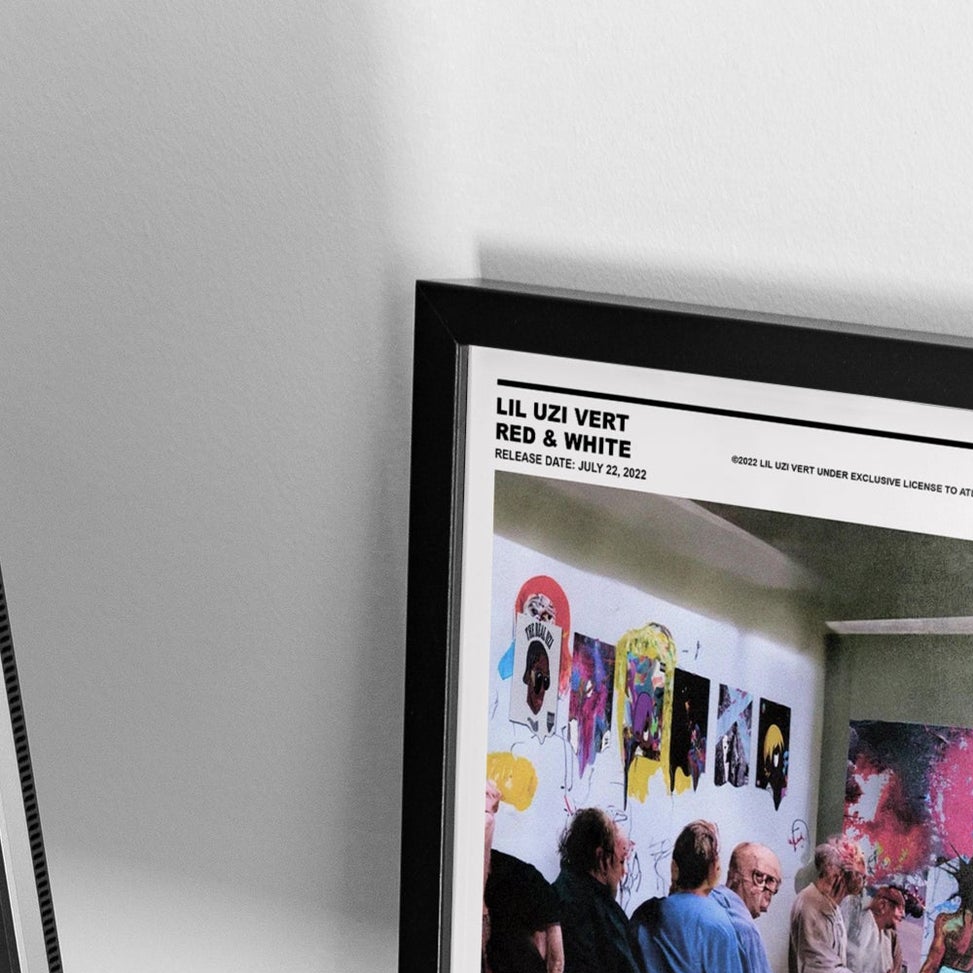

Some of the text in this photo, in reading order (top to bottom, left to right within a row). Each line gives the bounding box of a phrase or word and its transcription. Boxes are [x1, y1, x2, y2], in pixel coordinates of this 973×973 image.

[496, 397, 629, 432] LIL UZI VERT
[496, 422, 631, 458] RED & WHITE
[495, 448, 647, 480] RELEASE DATE: JULY 22, 2022
[731, 455, 758, 467] ©2022
[760, 459, 773, 469] LIL
[775, 461, 789, 471] UZI
[791, 464, 815, 474] VERT
[817, 468, 848, 479] UNDER
[851, 472, 901, 487] EXCLUSIVE
[903, 480, 942, 493] LICENSE
[945, 485, 958, 495] TO
